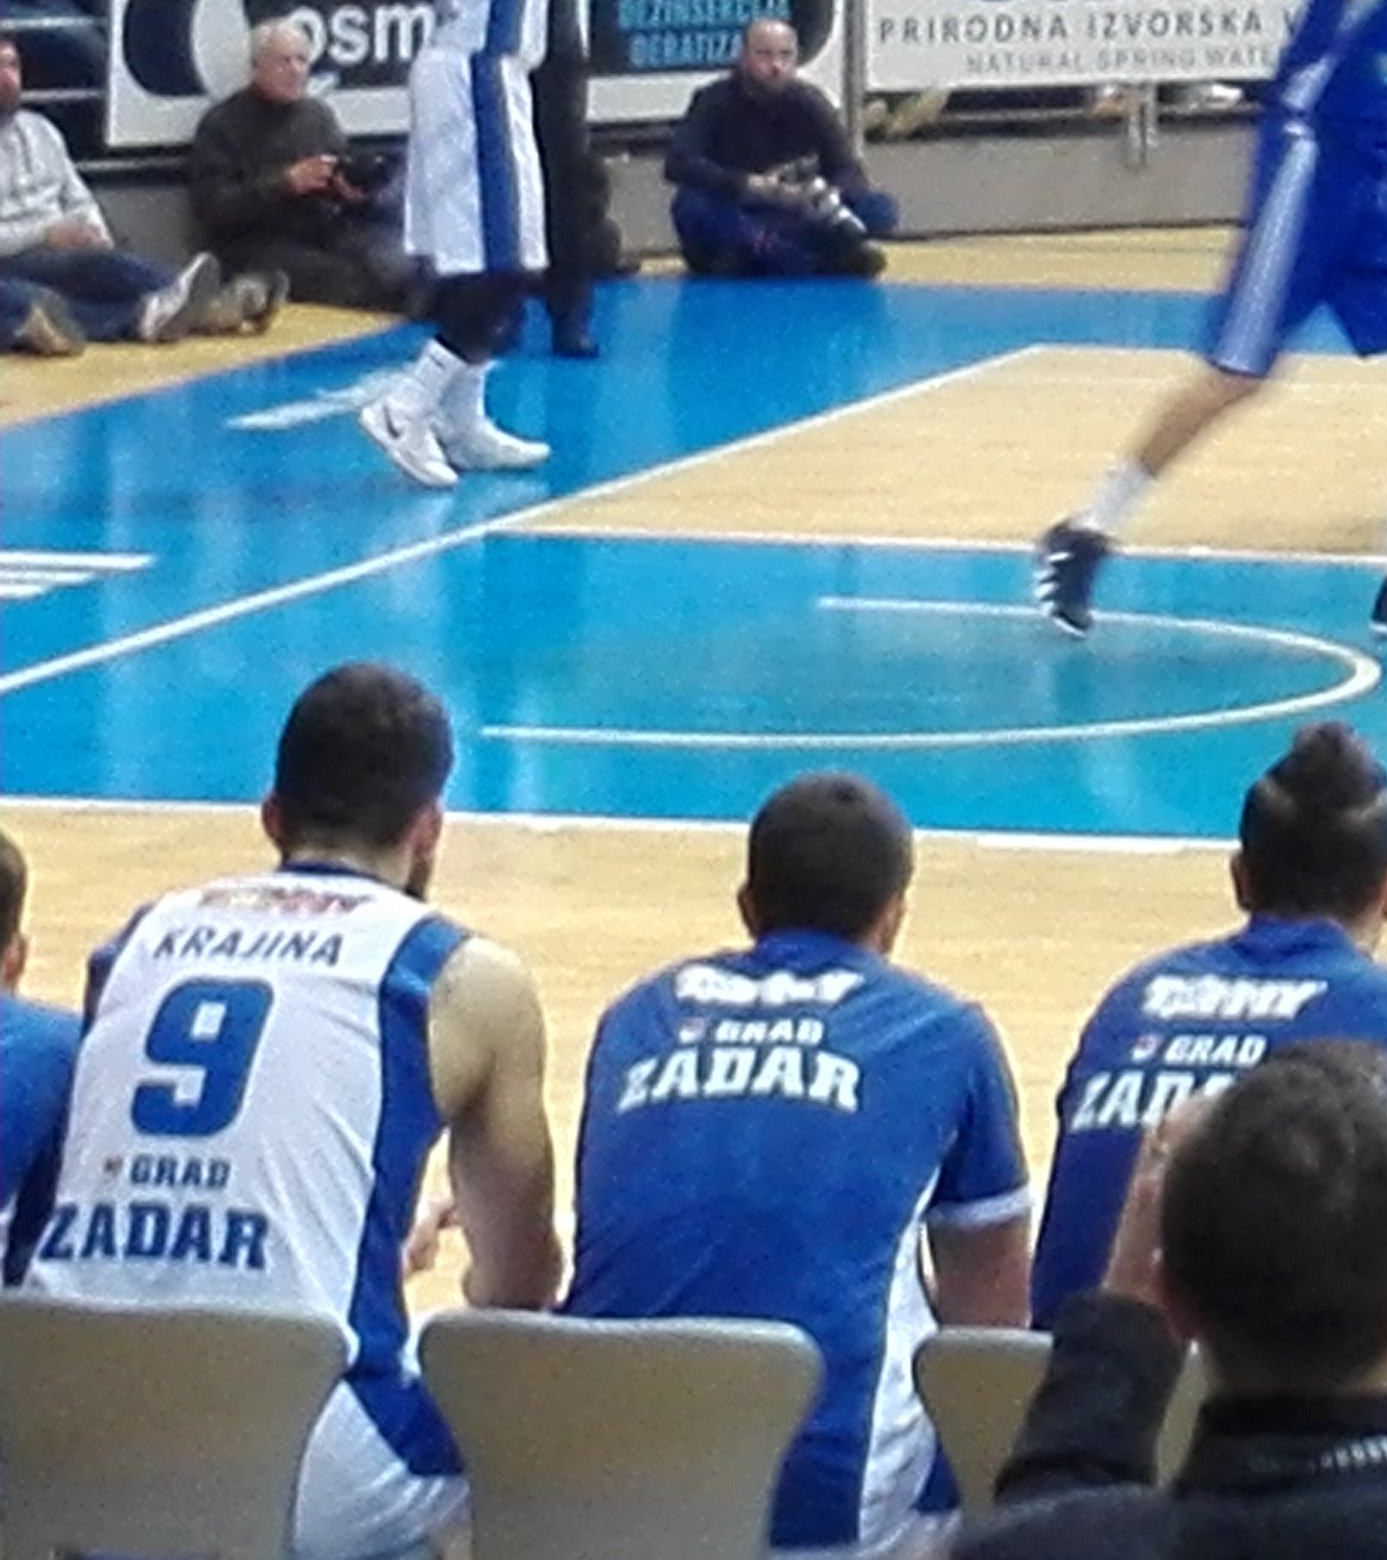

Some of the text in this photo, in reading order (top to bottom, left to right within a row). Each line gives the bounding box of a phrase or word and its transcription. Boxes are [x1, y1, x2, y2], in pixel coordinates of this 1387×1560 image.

[879, 13, 1068, 42] PRIRODNA
[1087, 8, 1263, 40] IZVORSKA
[966, 52, 1082, 75] NATURAL
[1099, 50, 1196, 72] SPRING
[153, 925, 346, 968] KRAJINA
[715, 1017, 825, 1045] GRAD
[130, 975, 275, 1138] 9
[1163, 1035, 1267, 1066] GRAD
[616, 1046, 860, 1115] ZADAR
[130, 1154, 231, 1190] GRAD
[36, 1201, 270, 1270] ZADAR
